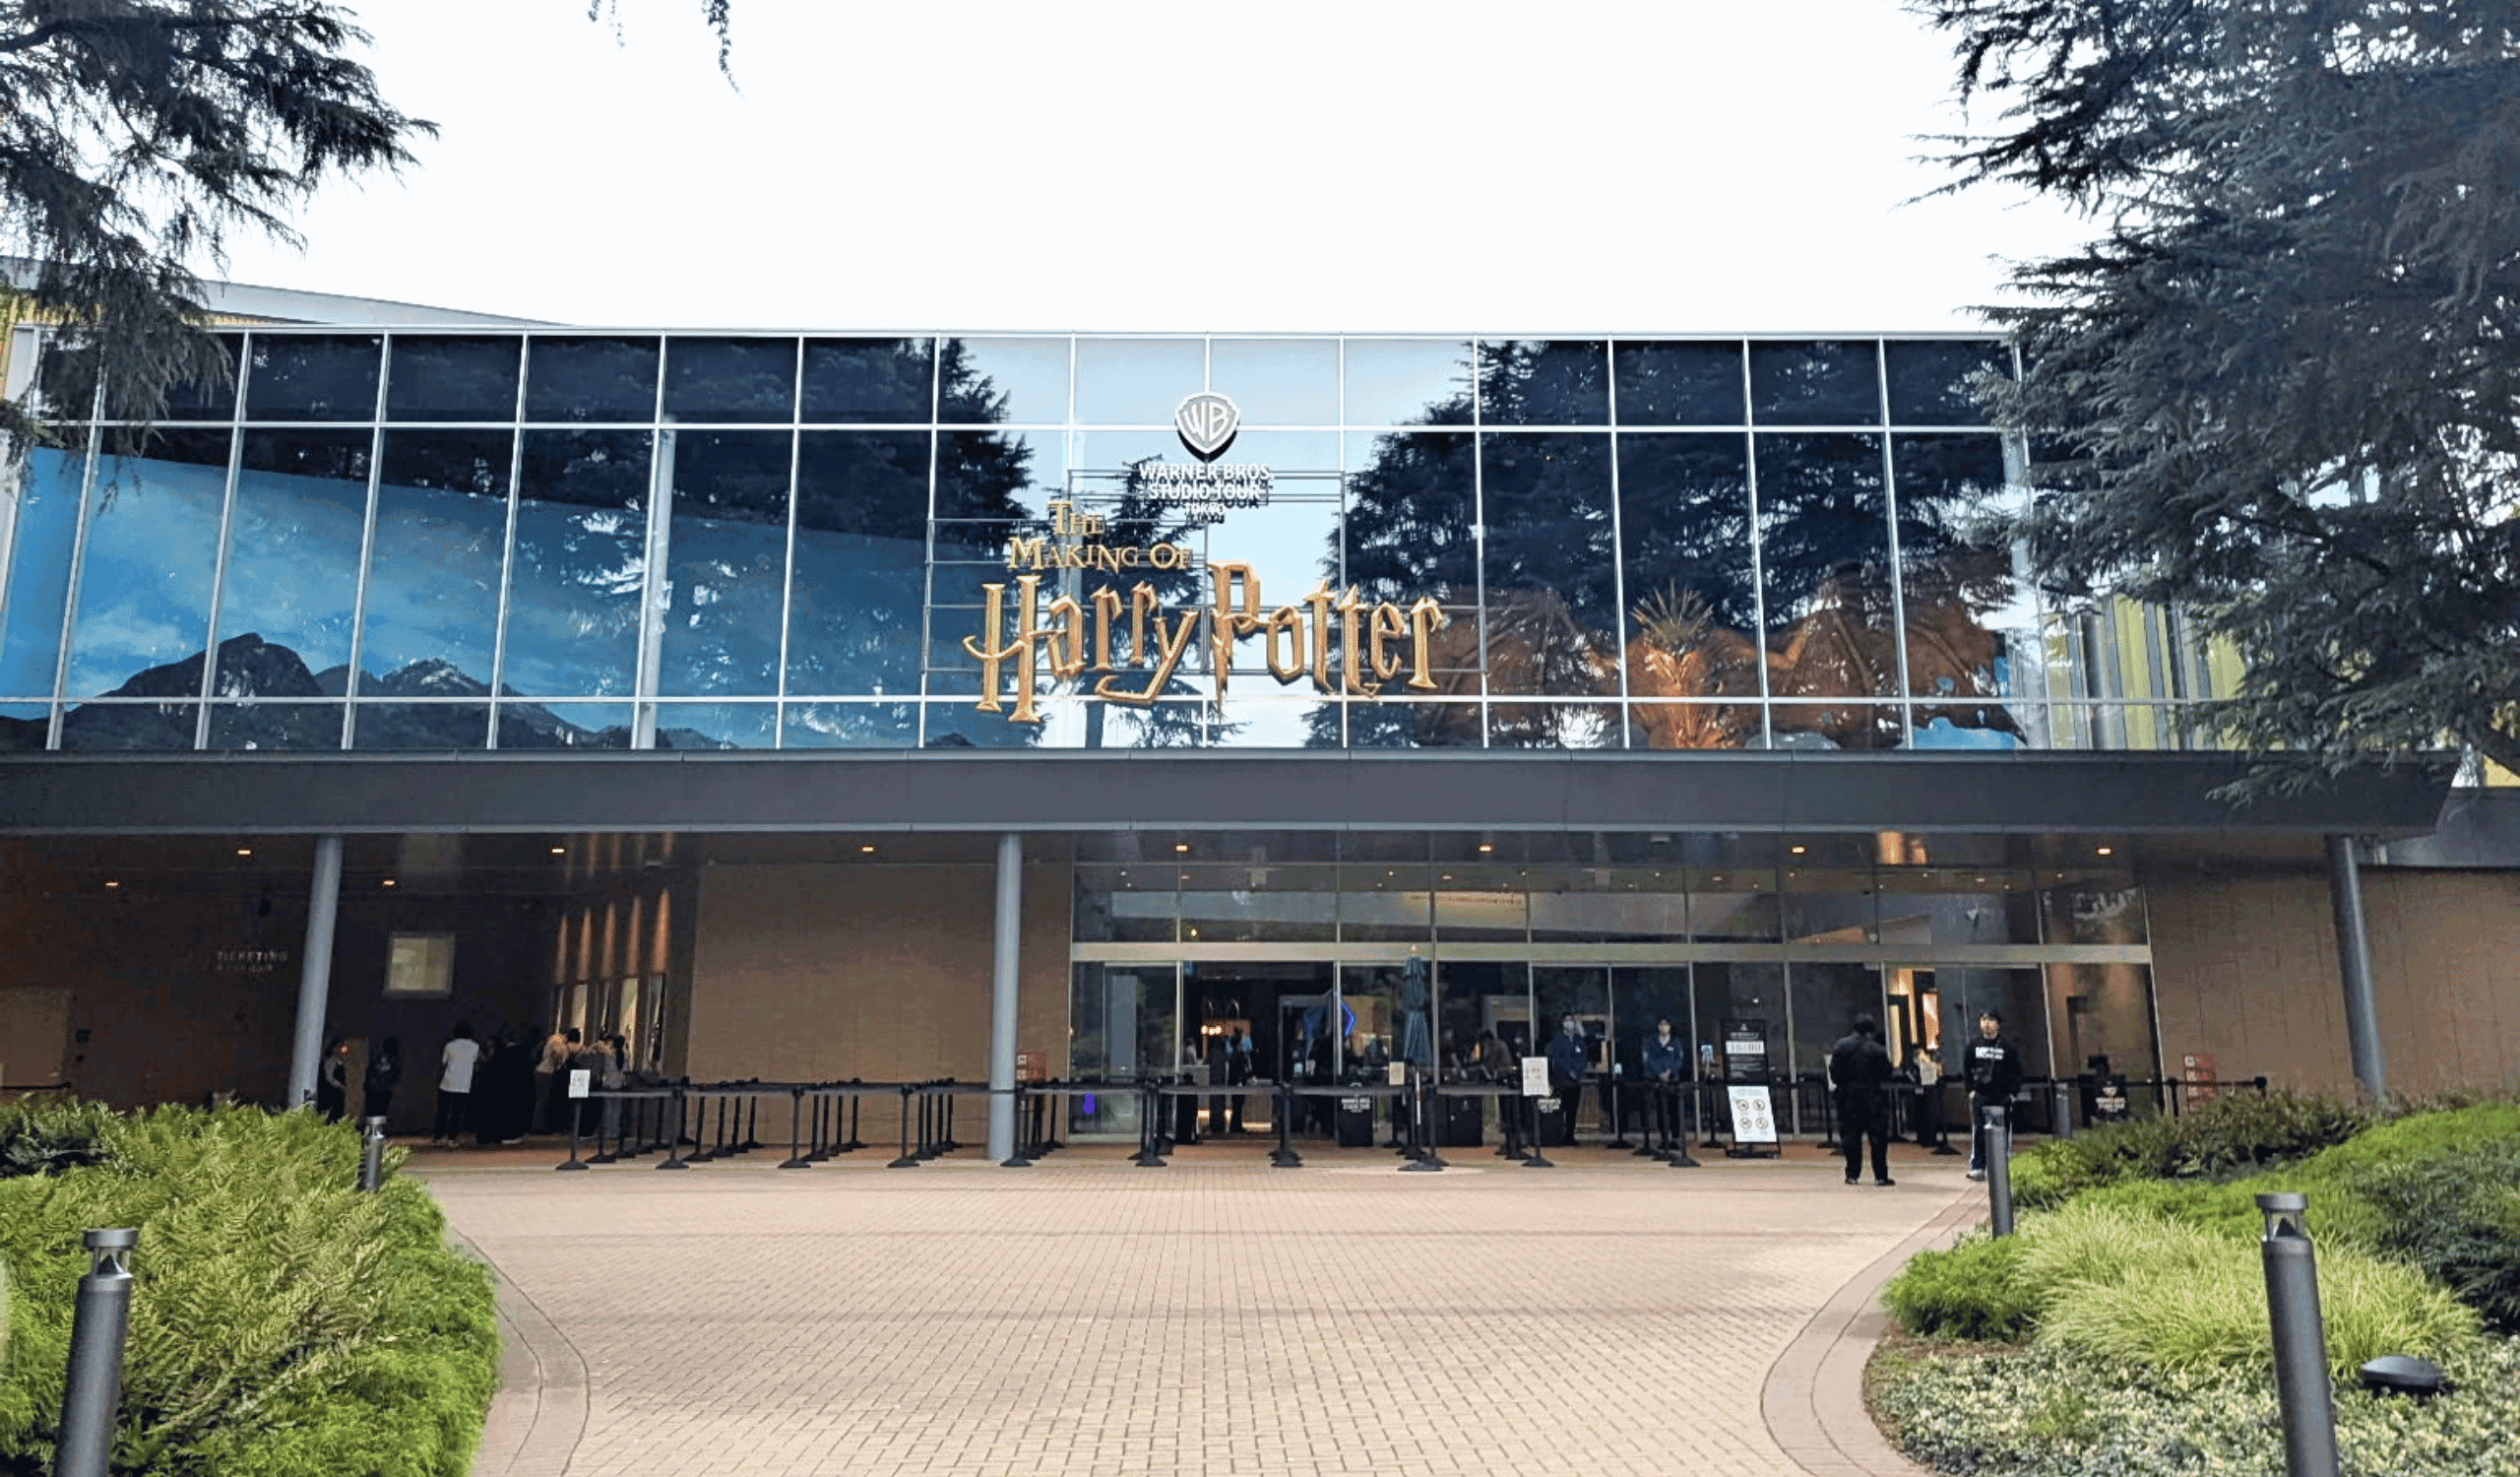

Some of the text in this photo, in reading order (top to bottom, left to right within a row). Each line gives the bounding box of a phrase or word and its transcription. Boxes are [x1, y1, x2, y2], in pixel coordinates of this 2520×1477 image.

[1182, 400, 1229, 443] WB
[1139, 463, 1276, 481] WARNER BROS.
[1148, 483, 1261, 500] STUDIO TOUR
[1184, 502, 1227, 515] TOKYO
[962, 560, 1444, 723] Harry Potter
